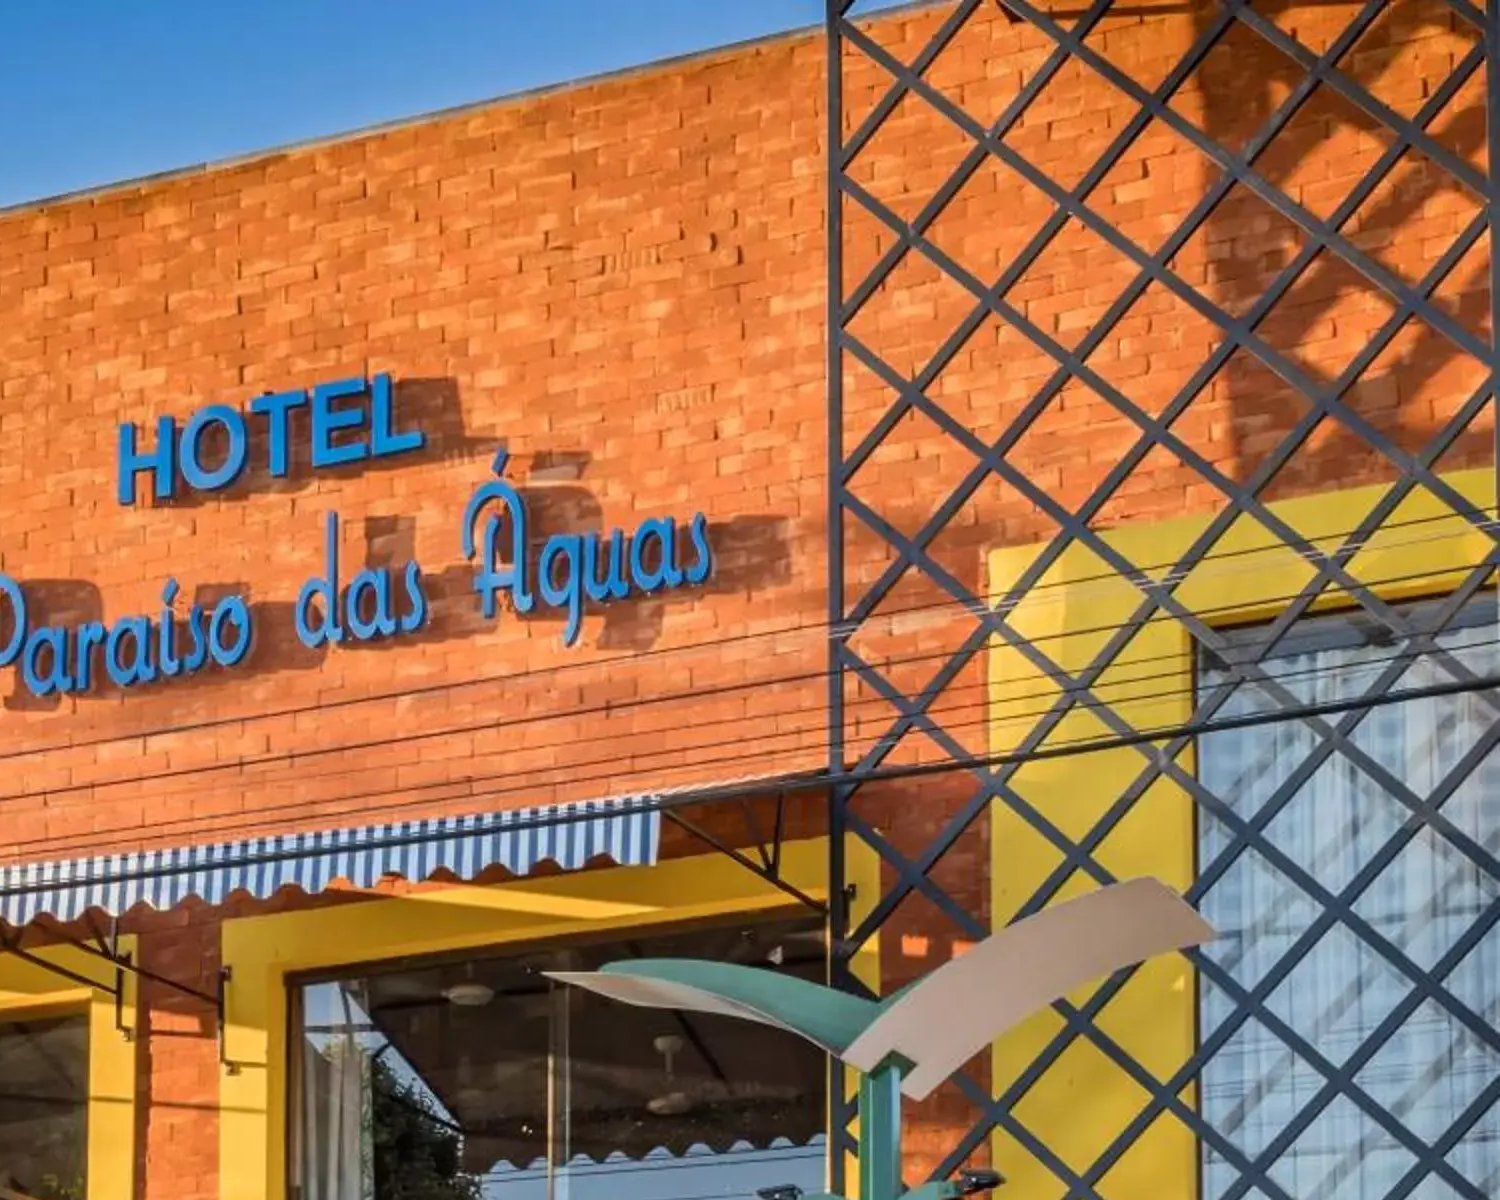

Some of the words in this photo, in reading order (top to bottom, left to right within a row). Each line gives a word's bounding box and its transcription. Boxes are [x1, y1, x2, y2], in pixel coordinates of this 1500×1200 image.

[117, 373, 426, 504] HOTEL
[295, 511, 428, 648] das
[462, 448, 713, 645] Águas
